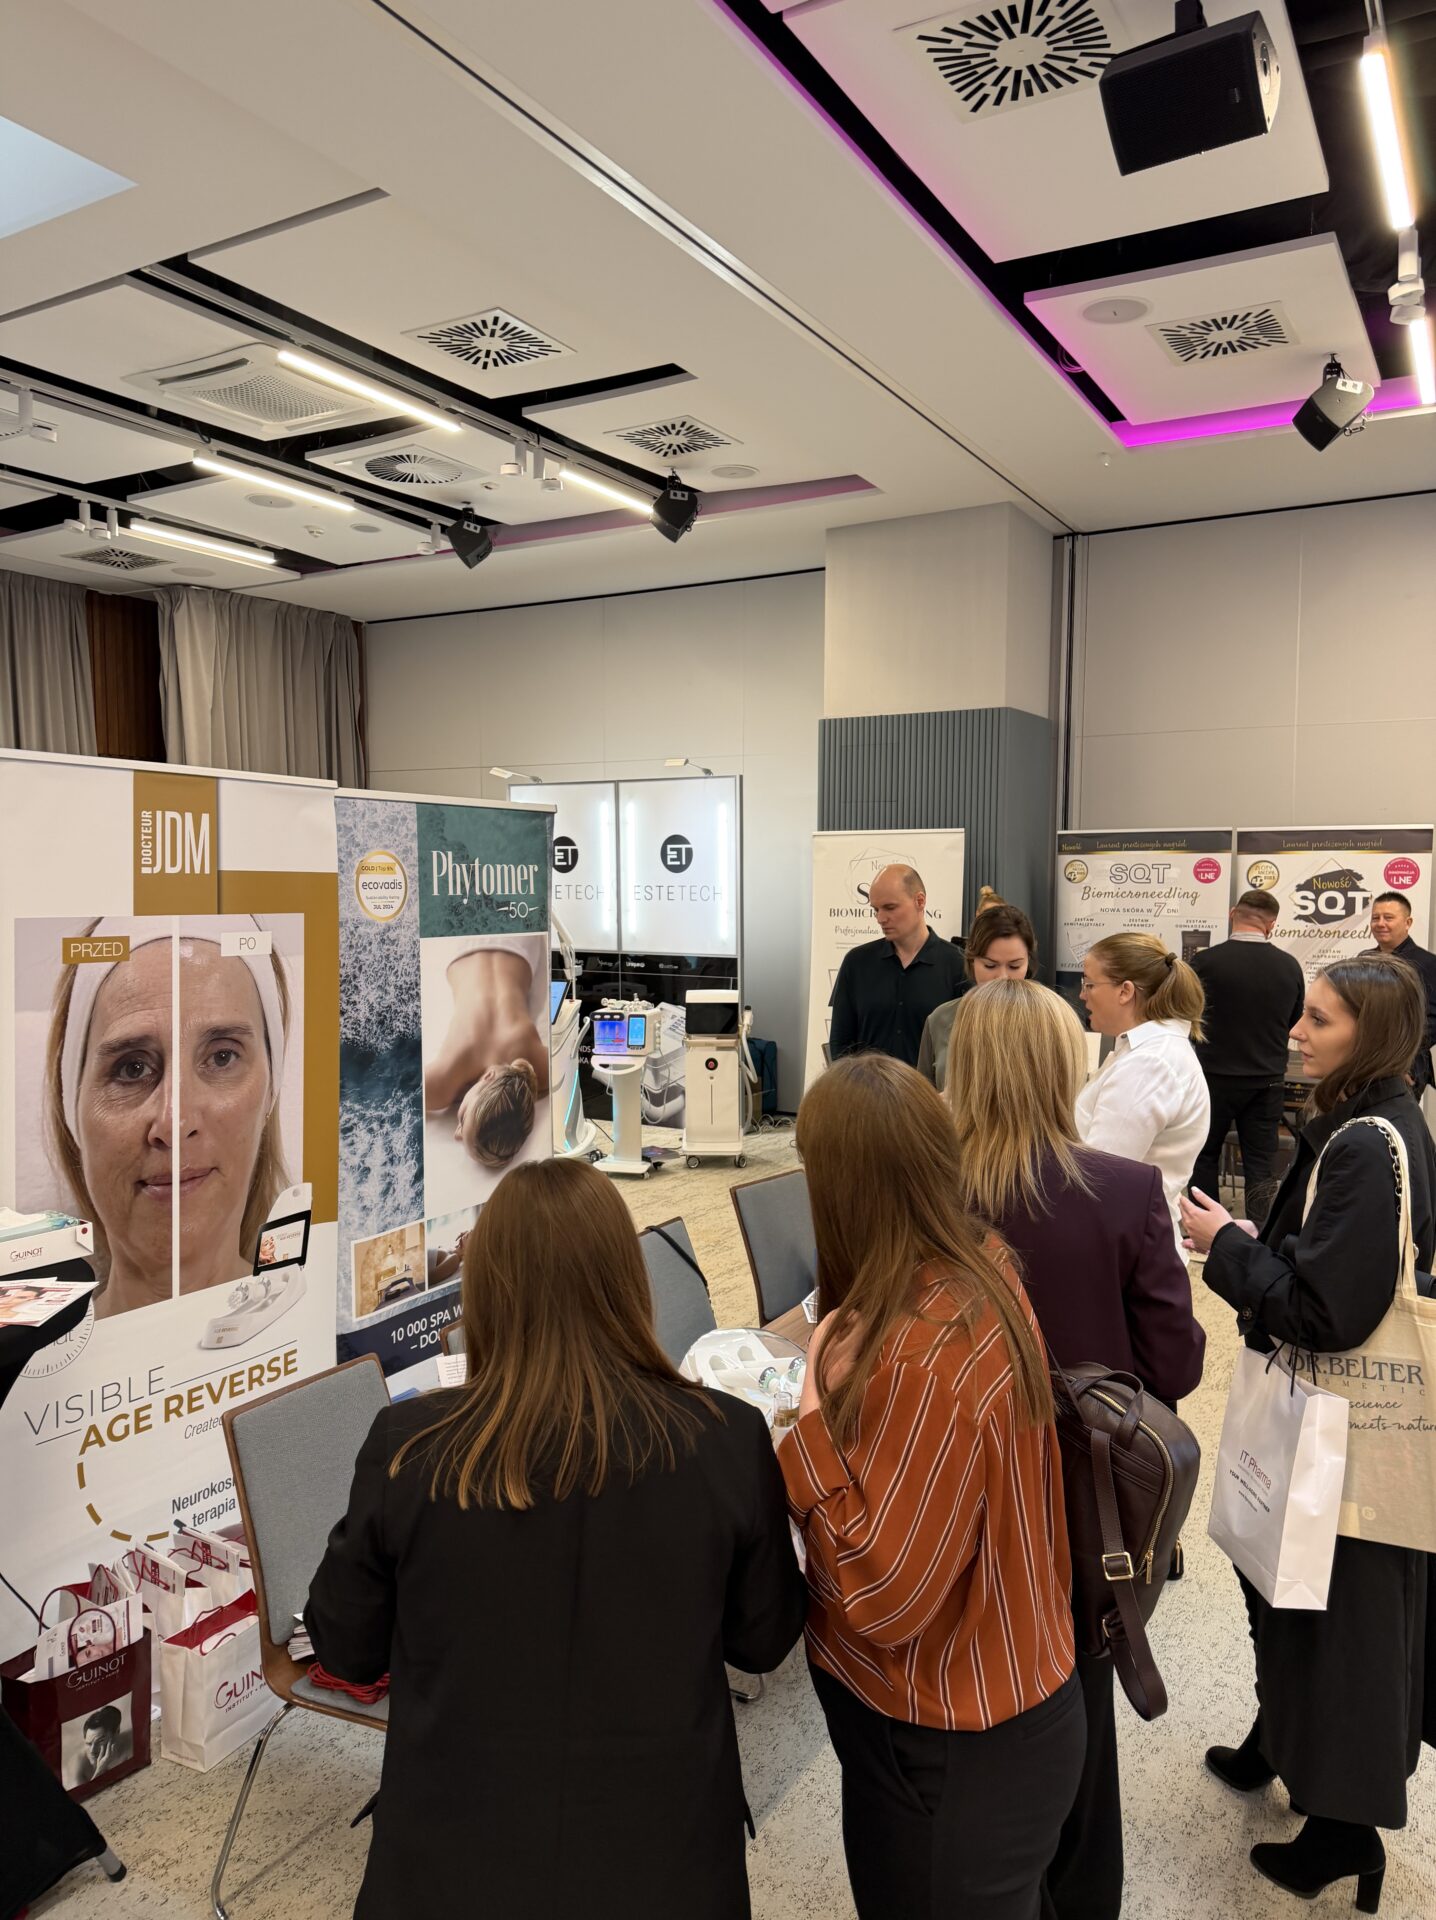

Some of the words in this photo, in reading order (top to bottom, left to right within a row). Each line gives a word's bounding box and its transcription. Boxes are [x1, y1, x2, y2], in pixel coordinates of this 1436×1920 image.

[141, 810, 152, 865] DOCTEUR
[153, 810, 210, 875] JDM
[431, 850, 539, 904] Phytomer
[1109, 863, 1172, 884] SQT
[1312, 875, 1351, 890] Nowość
[1393, 876, 1413, 885] LNE
[361, 879, 403, 890] ecovadis
[555, 884, 605, 901] ETECH
[634, 884, 722, 902] ESTETECH
[1081, 886, 1201, 906] Biomicroneedling
[1295, 891, 1371, 915] SQT
[1123, 906, 1145, 914] SKÓRA
[1153, 902, 1167, 917] 7
[1266, 924, 1372, 940] iomicroneed
[70, 941, 124, 958] PRZED
[239, 937, 257, 951] PO
[10, 1247, 43, 1259] GUINOT
[390, 1327, 405, 1344] 10
[406, 1317, 428, 1337] 000
[430, 1309, 451, 1328] SPA
[24, 1365, 166, 1436] VISIBLE
[79, 1403, 153, 1456] AGE
[164, 1348, 298, 1423] REVERSE
[1348, 1400, 1402, 1409] science
[1348, 1415, 1391, 1431] meets
[1248, 1456, 1272, 1490] Pharma
[171, 1477, 235, 1514] Neurokos
[192, 1498, 236, 1527] terapia
[66, 1652, 127, 1689] GUINOT
[214, 1664, 263, 1709] GUIN
[225, 1690, 253, 1713] INSTITUT
